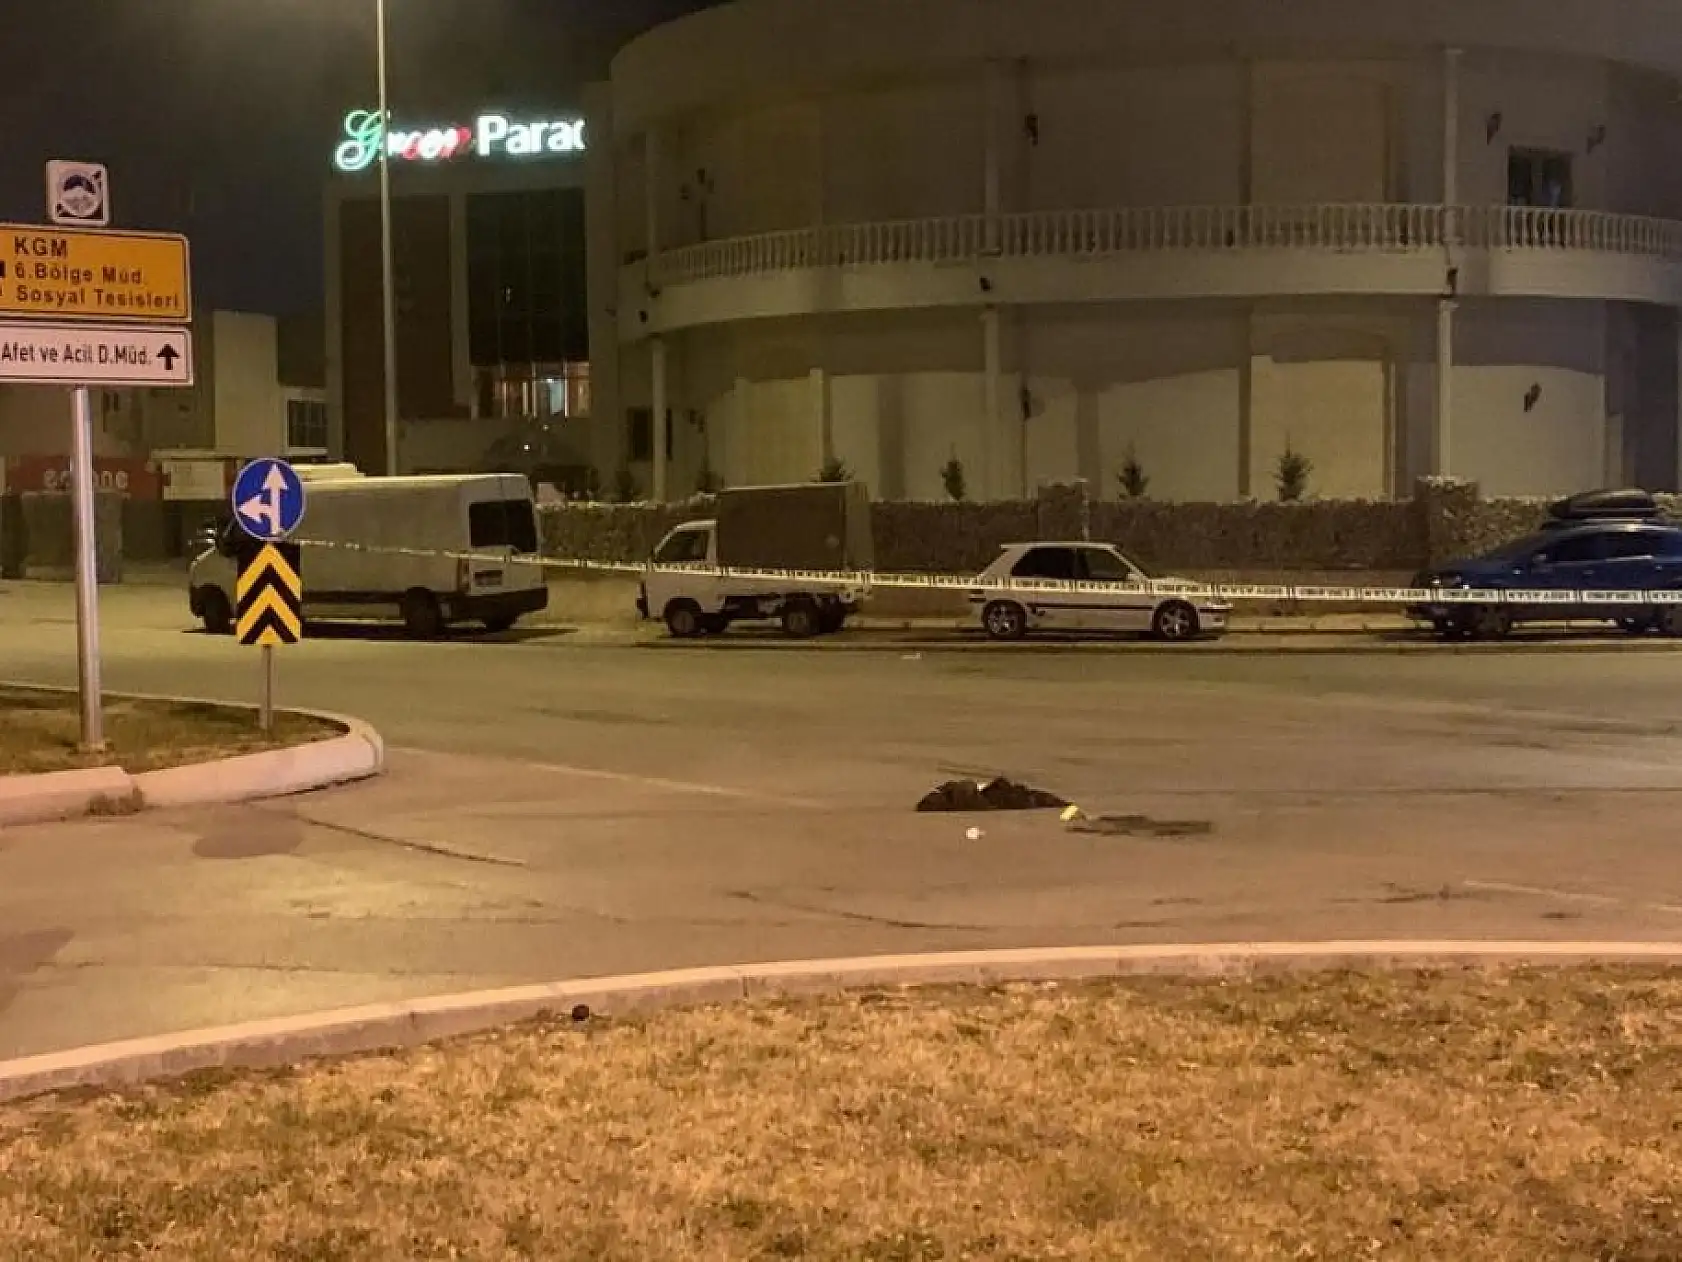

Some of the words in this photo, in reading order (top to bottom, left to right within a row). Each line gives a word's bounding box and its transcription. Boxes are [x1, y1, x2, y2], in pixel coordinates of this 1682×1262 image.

[14, 235, 68, 257] KGM
[14, 261, 93, 285] 6.Bölge
[16, 285, 85, 307] Sosyal
[94, 288, 179, 308] Tesisleri
[1, 341, 36, 362] Afet
[40, 345, 59, 363] ve
[63, 343, 93, 364] Acil
[98, 343, 152, 365] D.Müd.
